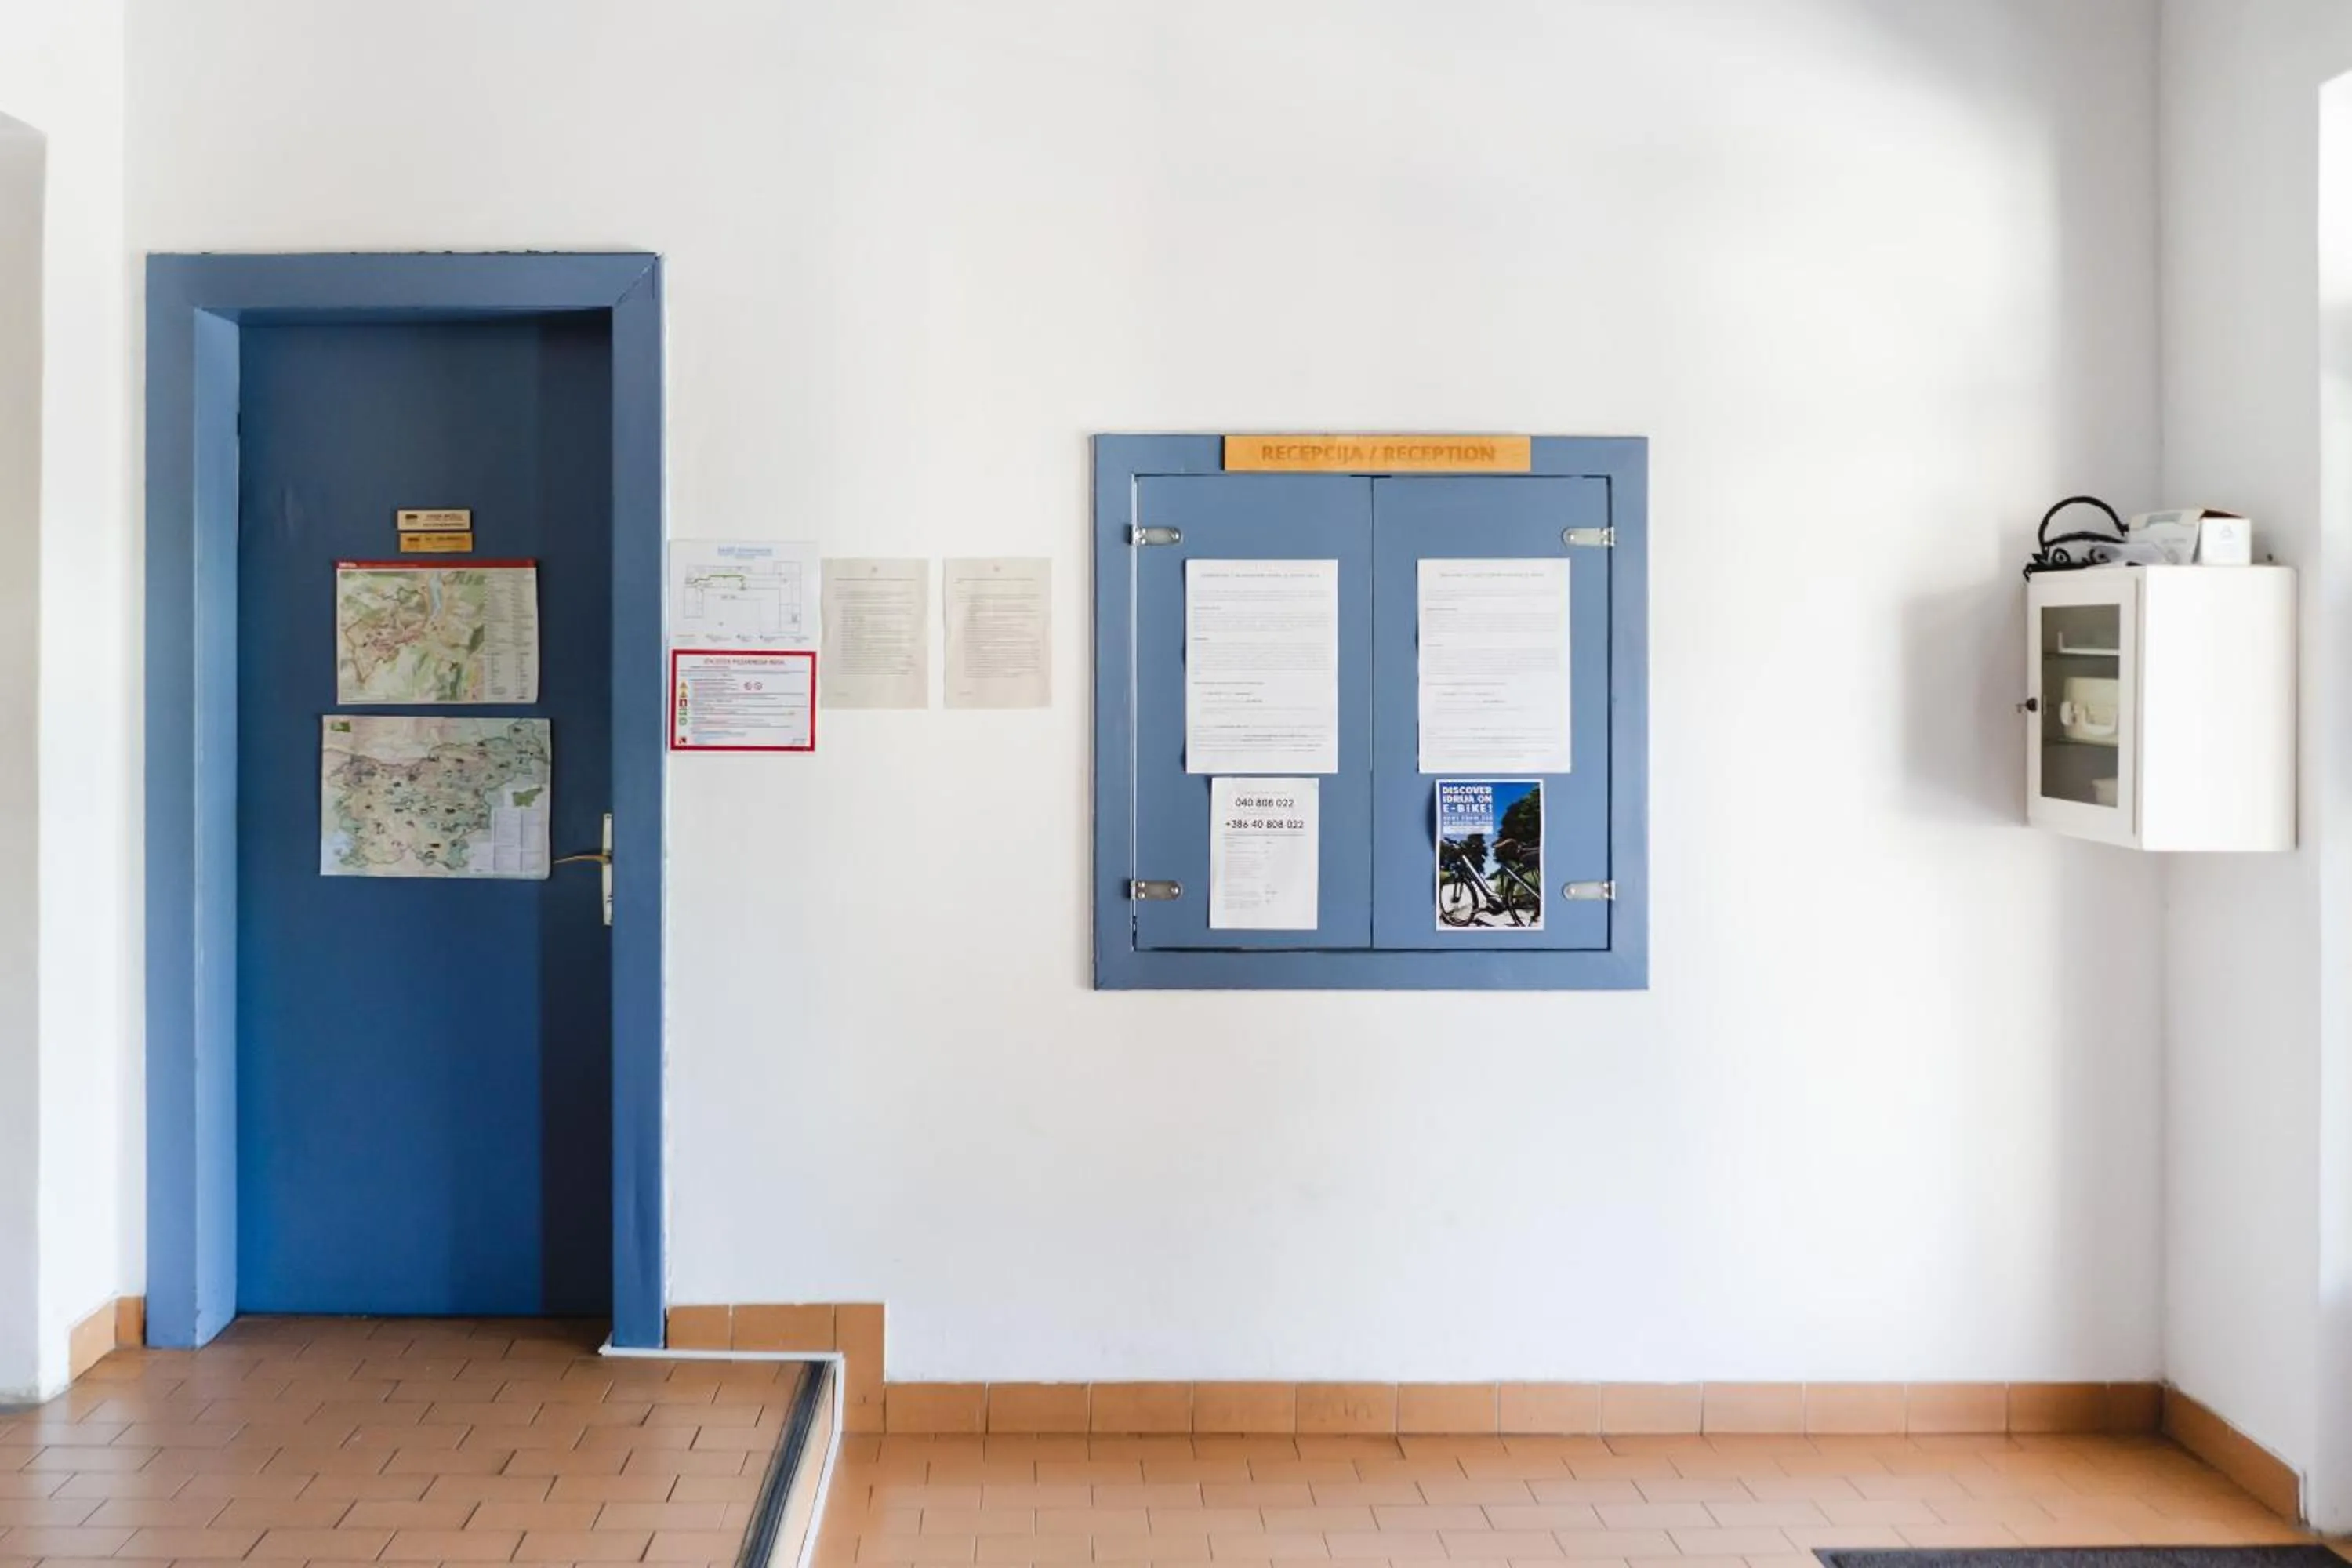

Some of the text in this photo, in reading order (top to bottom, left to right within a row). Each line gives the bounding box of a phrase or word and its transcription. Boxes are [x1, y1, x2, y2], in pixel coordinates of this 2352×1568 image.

[1261, 445, 1496, 463] RECEPCIJA / RECEPTION
[1442, 786, 1493, 794] DISCOVER
[1235, 797, 1254, 807] 040
[1276, 798, 1294, 808] 022
[1478, 794, 1493, 803] ON
[1225, 819, 1304, 829] +386 40 808 022
